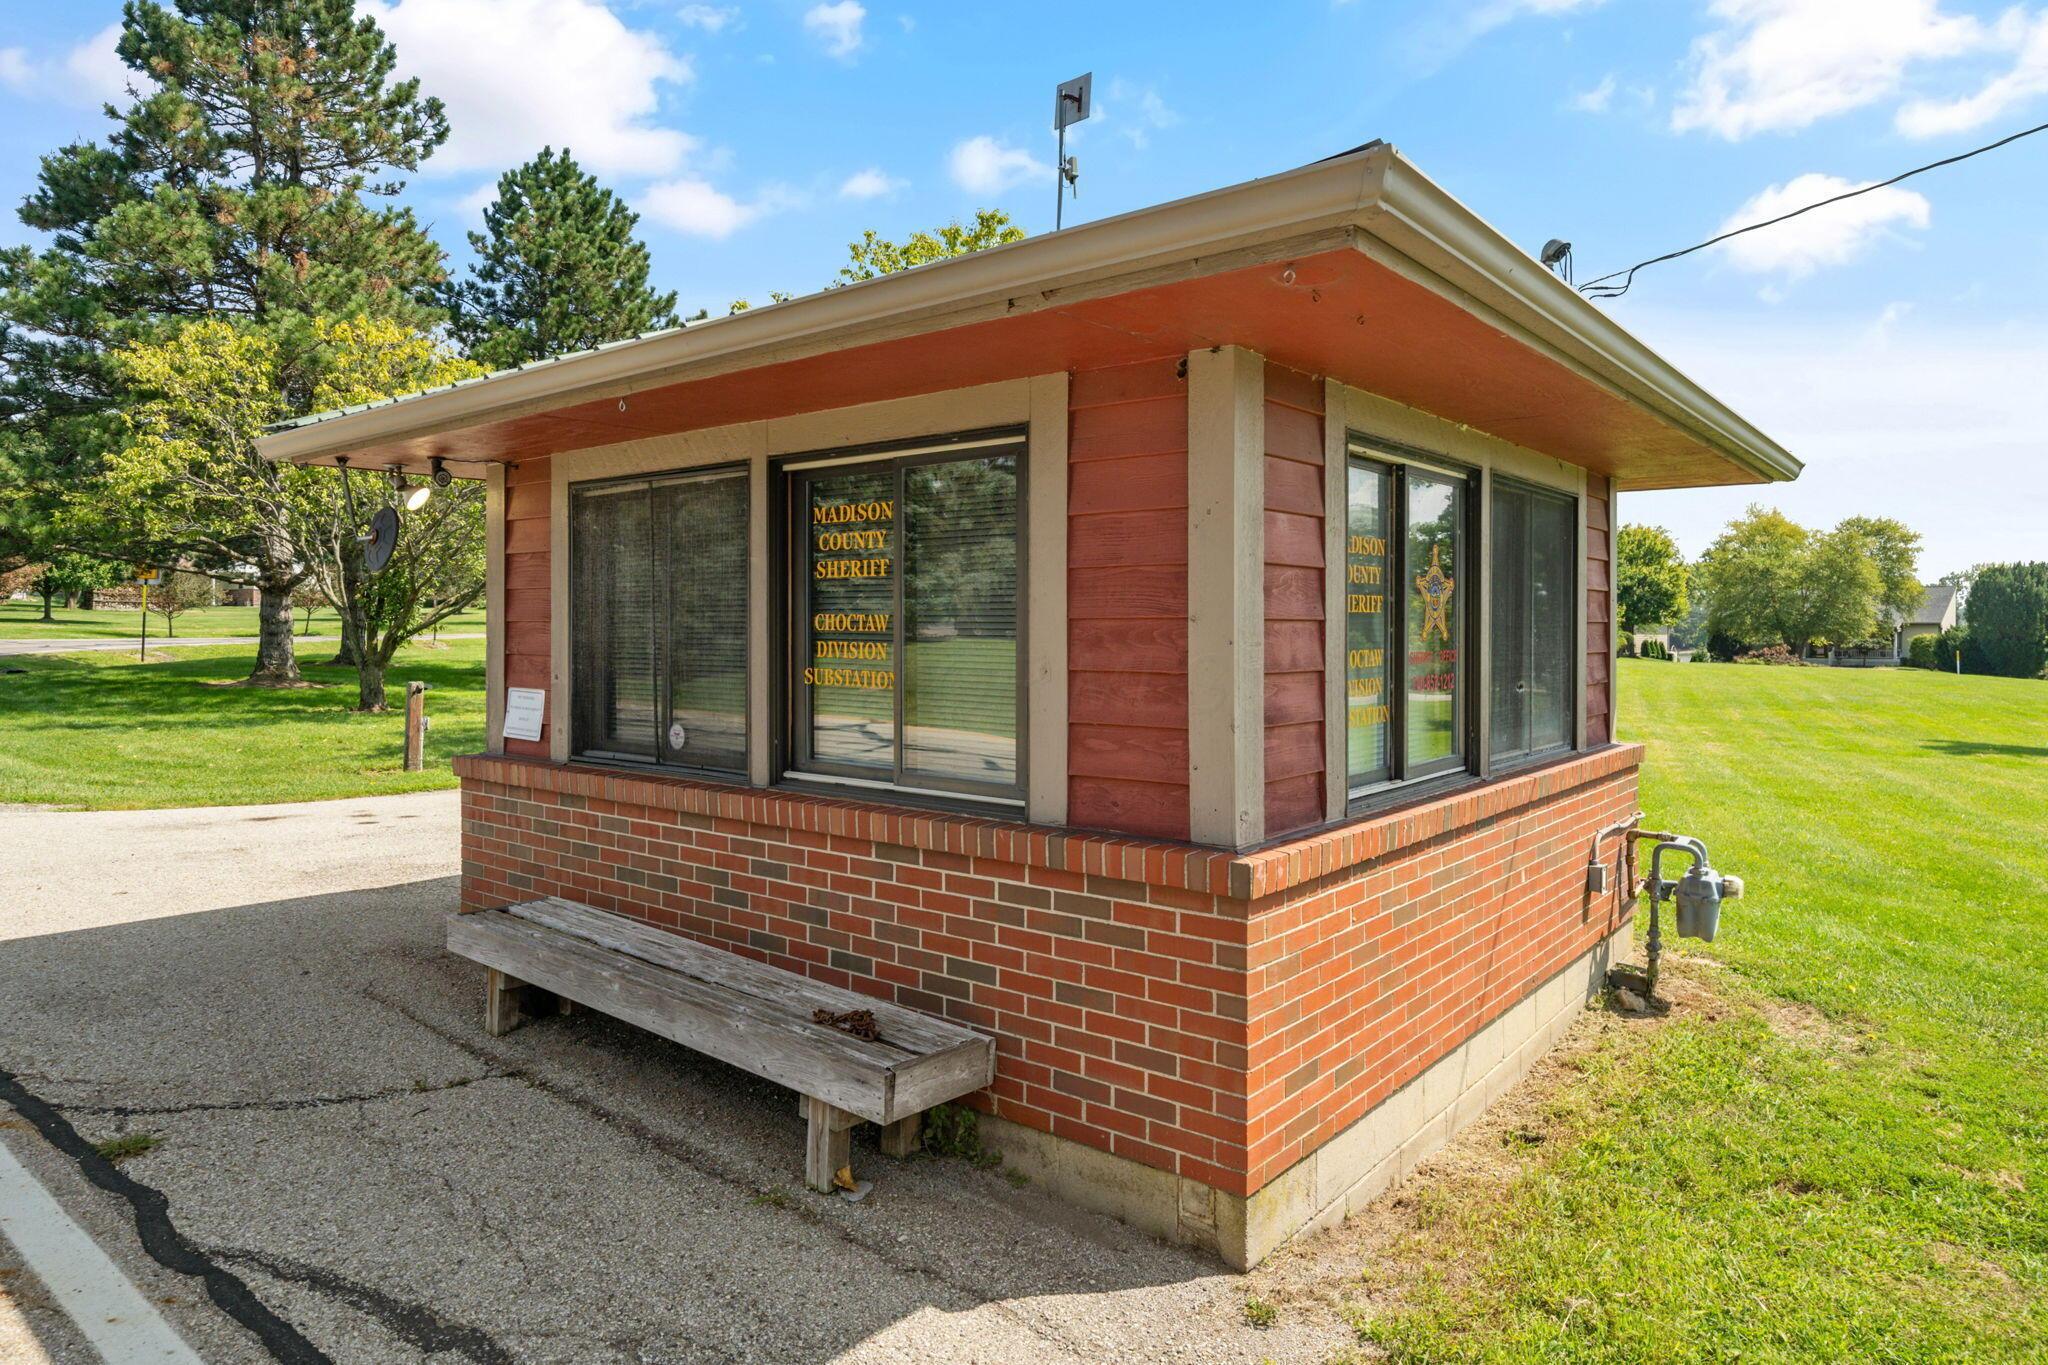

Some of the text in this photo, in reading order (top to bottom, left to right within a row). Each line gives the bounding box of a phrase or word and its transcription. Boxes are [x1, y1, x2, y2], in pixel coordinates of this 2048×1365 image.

[813, 501, 894, 524] MADISON
[819, 529, 887, 551] COUNTY
[1348, 536, 1386, 556] DISON
[816, 559, 890, 579] SHERIFF
[815, 613, 889, 632] CHOCTAW
[816, 641, 887, 660] DIVISION
